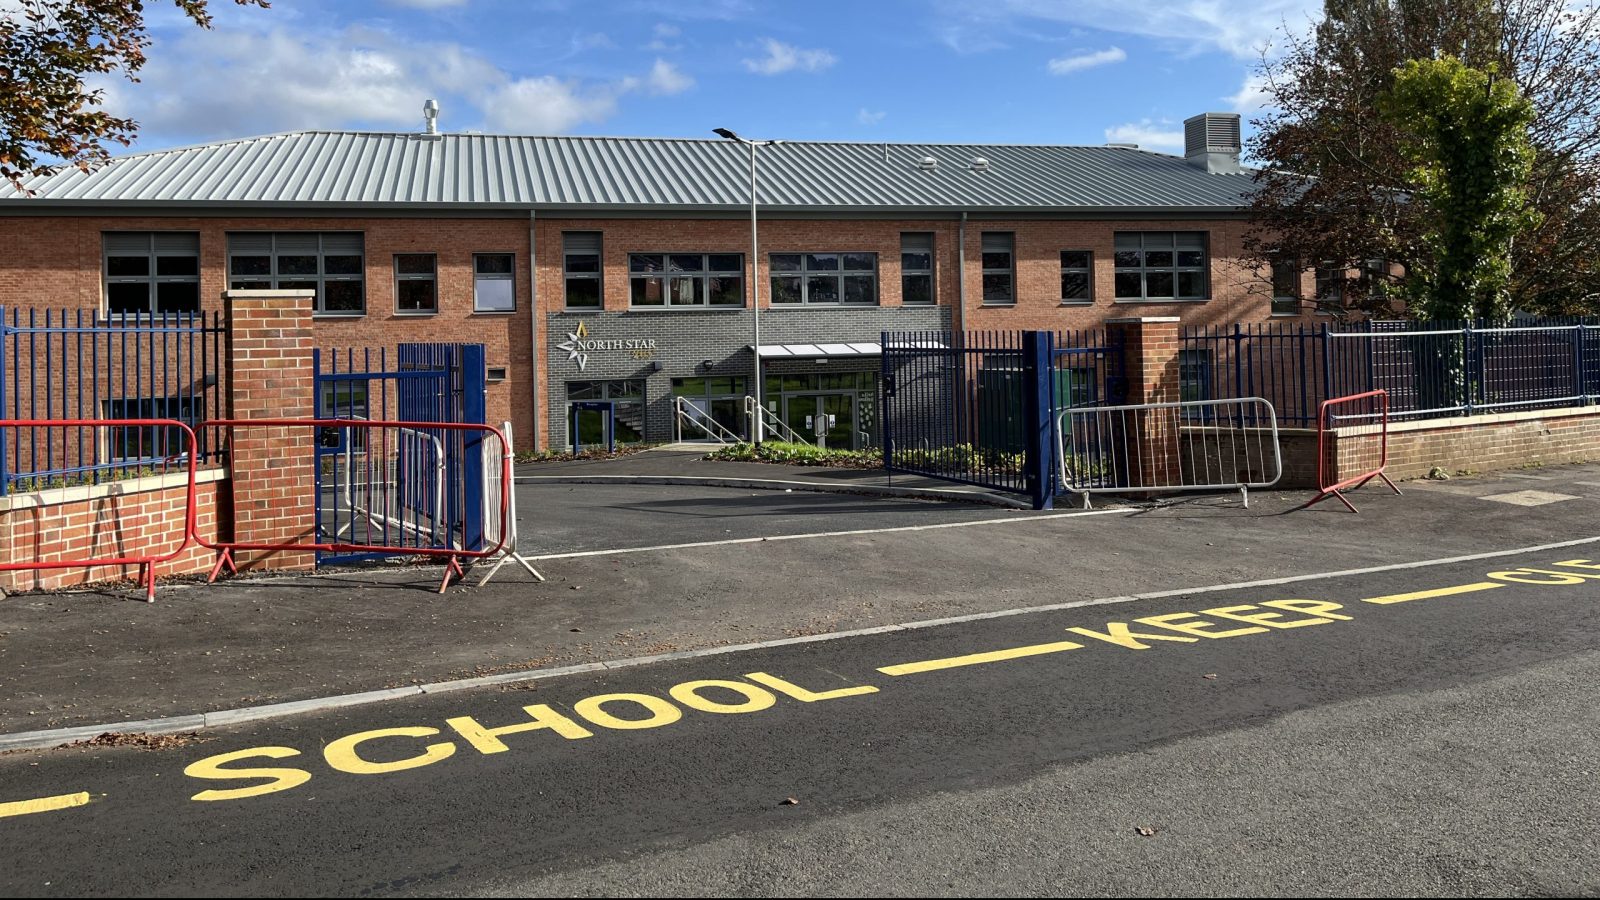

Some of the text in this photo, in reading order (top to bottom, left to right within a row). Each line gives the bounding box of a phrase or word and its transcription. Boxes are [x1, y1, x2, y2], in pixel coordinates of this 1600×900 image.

[577, 339, 656, 351] NORTH STAR
[184, 671, 880, 802] SCHOOL
[1065, 599, 1354, 650] KEEP
